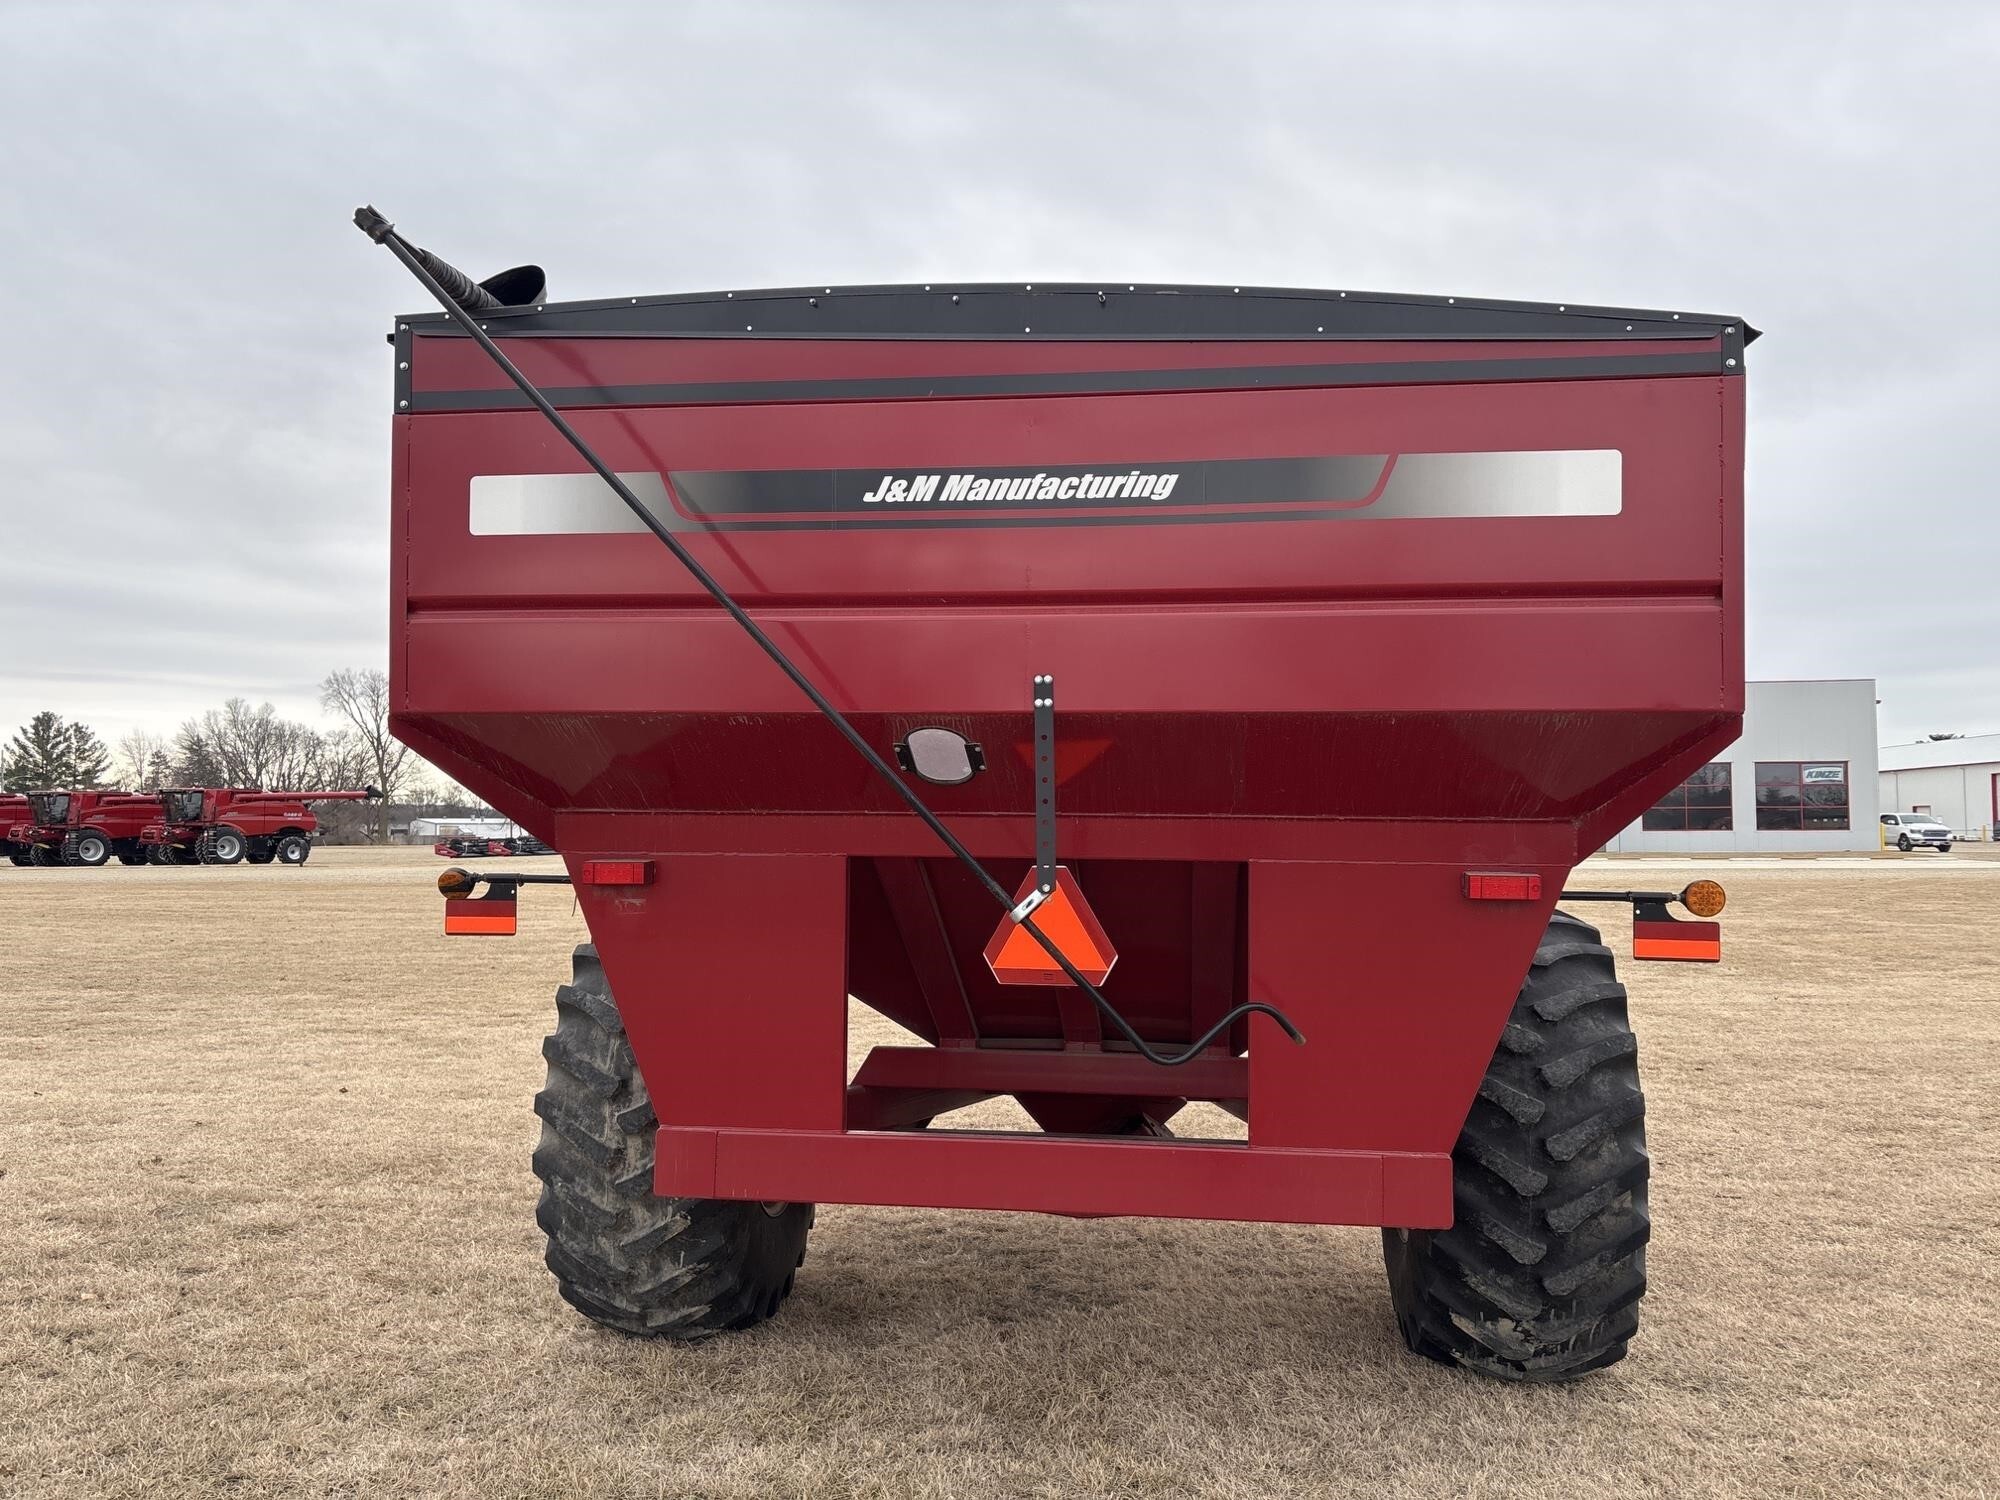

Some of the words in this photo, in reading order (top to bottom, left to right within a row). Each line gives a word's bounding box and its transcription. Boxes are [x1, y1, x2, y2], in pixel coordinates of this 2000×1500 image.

[862, 475, 941, 502] J&M
[939, 470, 1179, 501] Manufacturing
[1806, 770, 1841, 779] KINZE
